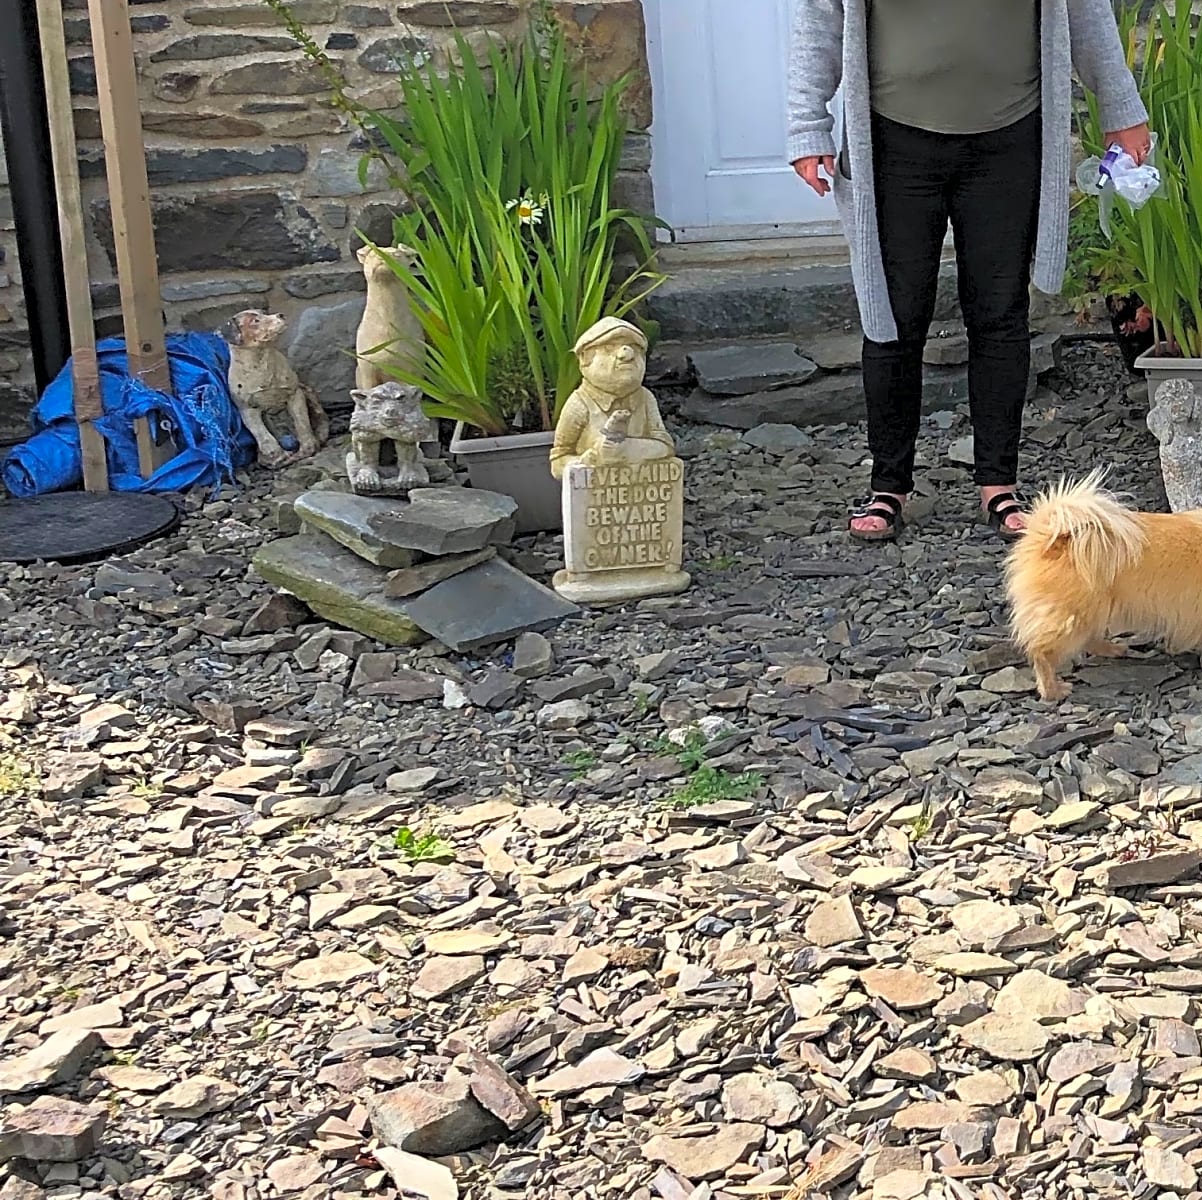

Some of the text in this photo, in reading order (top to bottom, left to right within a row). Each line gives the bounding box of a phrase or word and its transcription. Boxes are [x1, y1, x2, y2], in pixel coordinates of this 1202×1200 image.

[570, 462, 681, 489] NEVER MIND
[593, 483, 673, 506] THE DOG
[586, 502, 667, 527] BEWARE
[596, 522, 662, 545] OF THE
[584, 541, 674, 567] OWNER!
